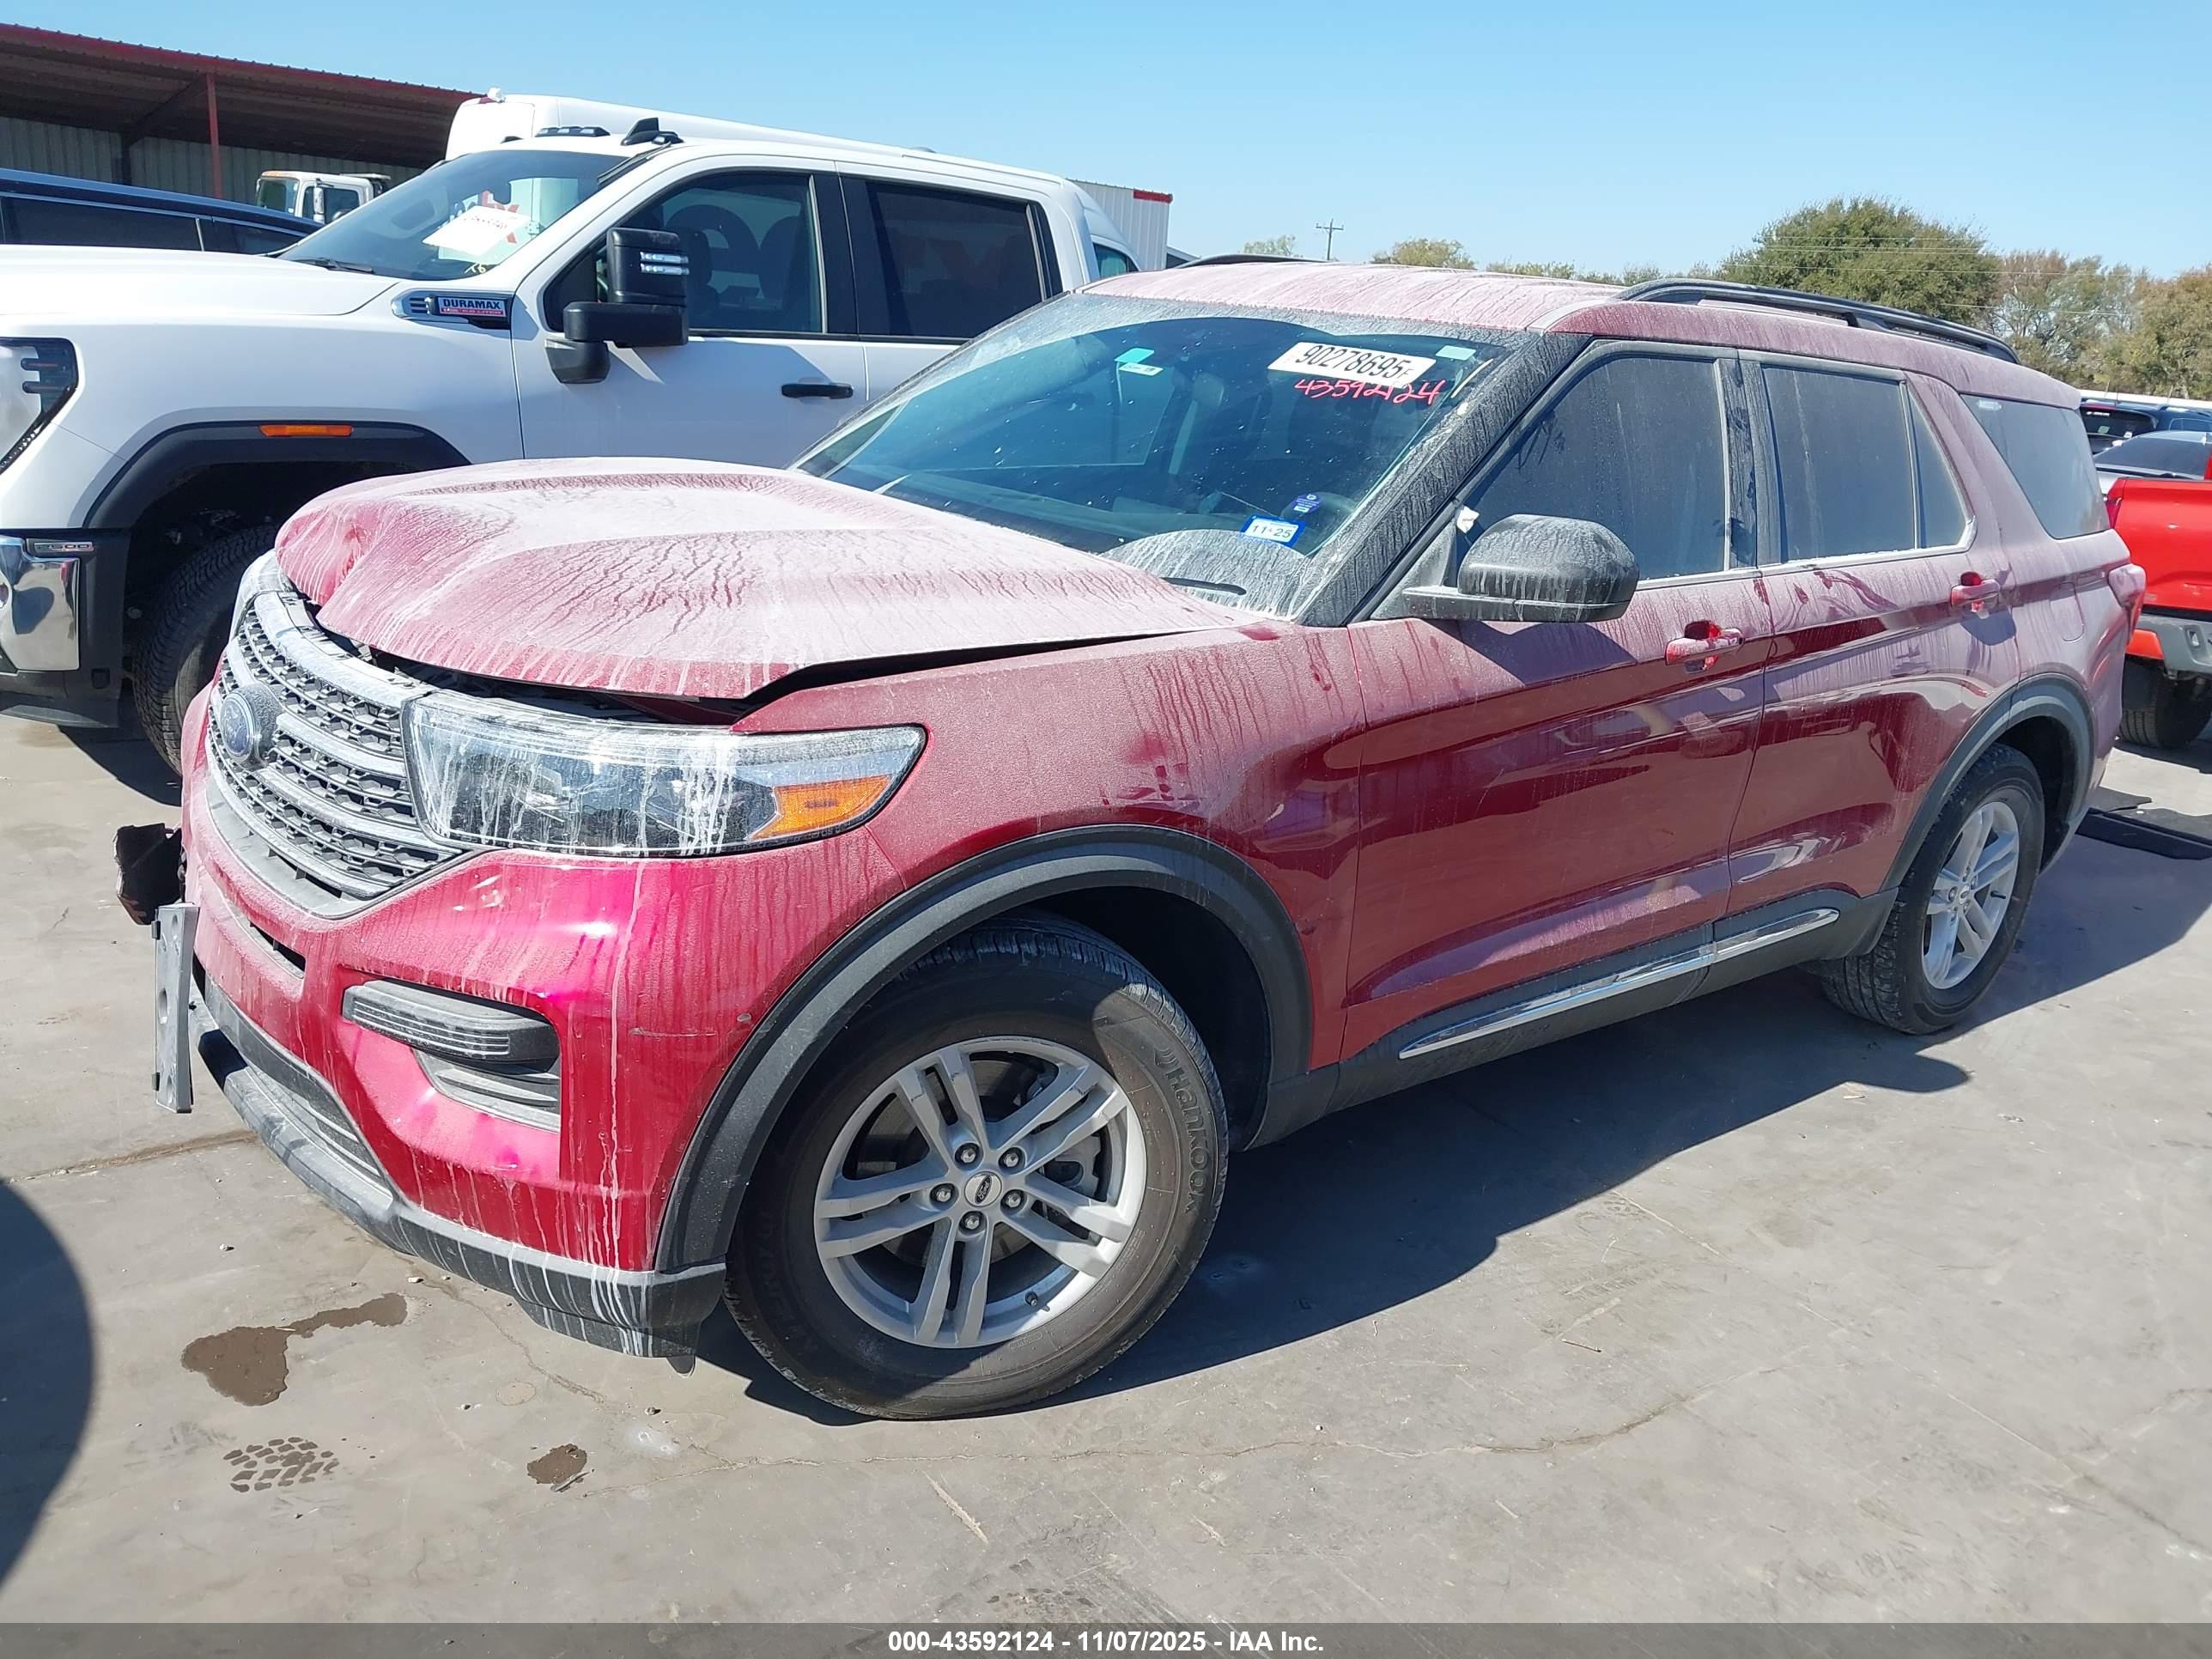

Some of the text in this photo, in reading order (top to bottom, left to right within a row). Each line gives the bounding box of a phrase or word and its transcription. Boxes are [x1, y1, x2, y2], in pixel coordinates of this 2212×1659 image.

[442, 298, 501, 310] DURAMAX
[1295, 344, 1412, 380] 90278695
[1273, 527, 1293, 538] 25
